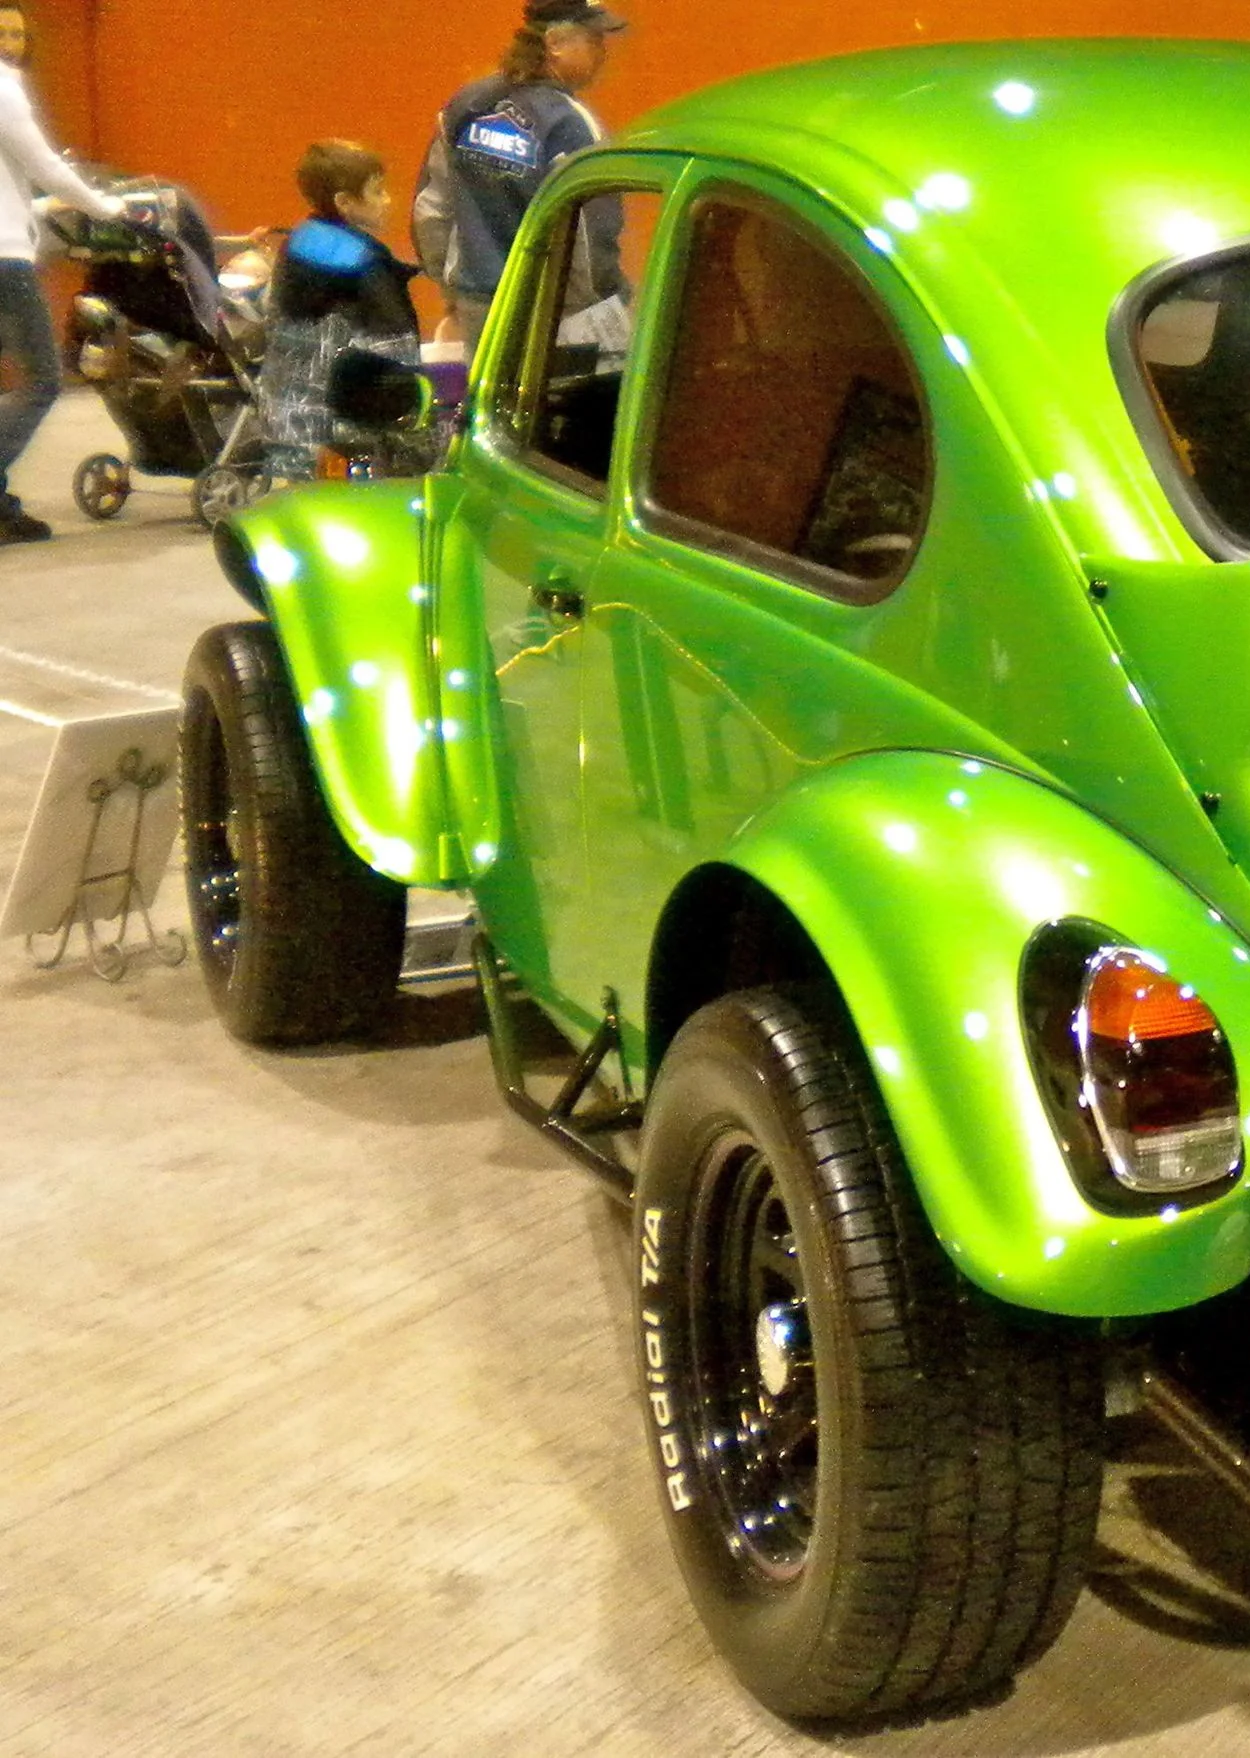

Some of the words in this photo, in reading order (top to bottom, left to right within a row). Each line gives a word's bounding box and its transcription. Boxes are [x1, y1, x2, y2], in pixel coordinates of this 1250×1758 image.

[469, 123, 530, 157] LOWE'S
[641, 1208, 662, 1288] T/A
[642, 1309, 693, 1512] Radial
